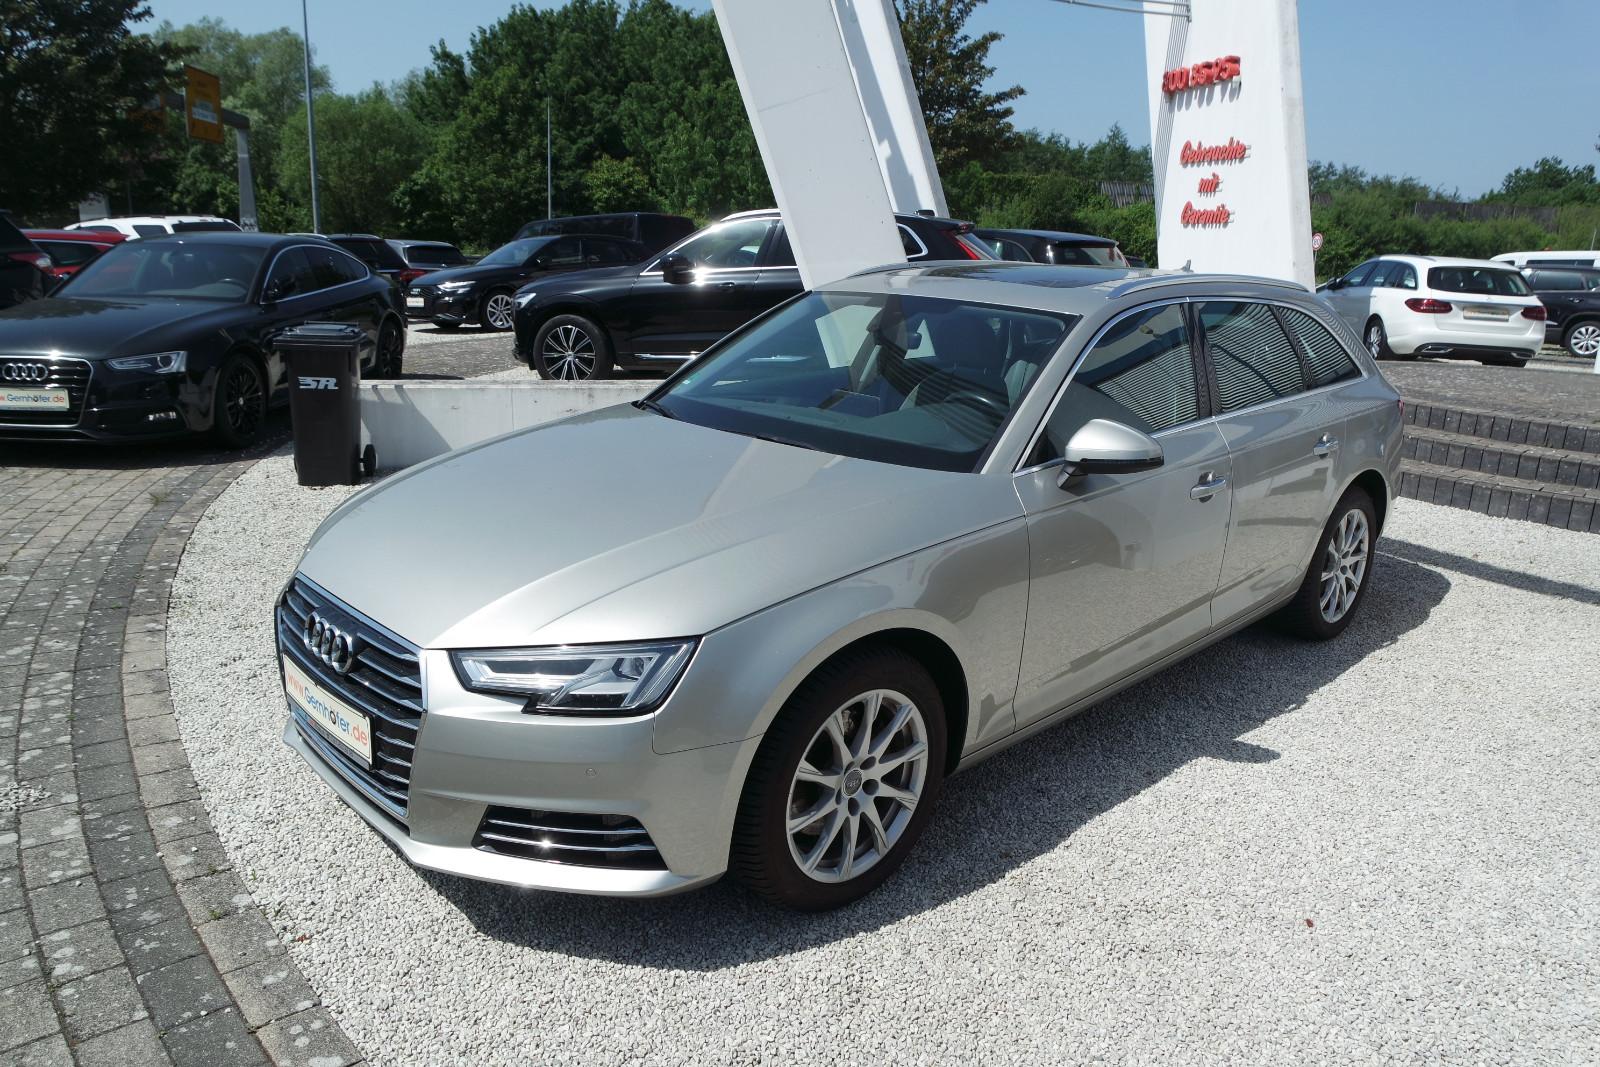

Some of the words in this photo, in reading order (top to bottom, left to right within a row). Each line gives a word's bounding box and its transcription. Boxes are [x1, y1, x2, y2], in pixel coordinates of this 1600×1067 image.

[1180, 137, 1246, 165] Gebrauchte
[1198, 172, 1220, 193] mit
[1181, 200, 1230, 224] Garantie
